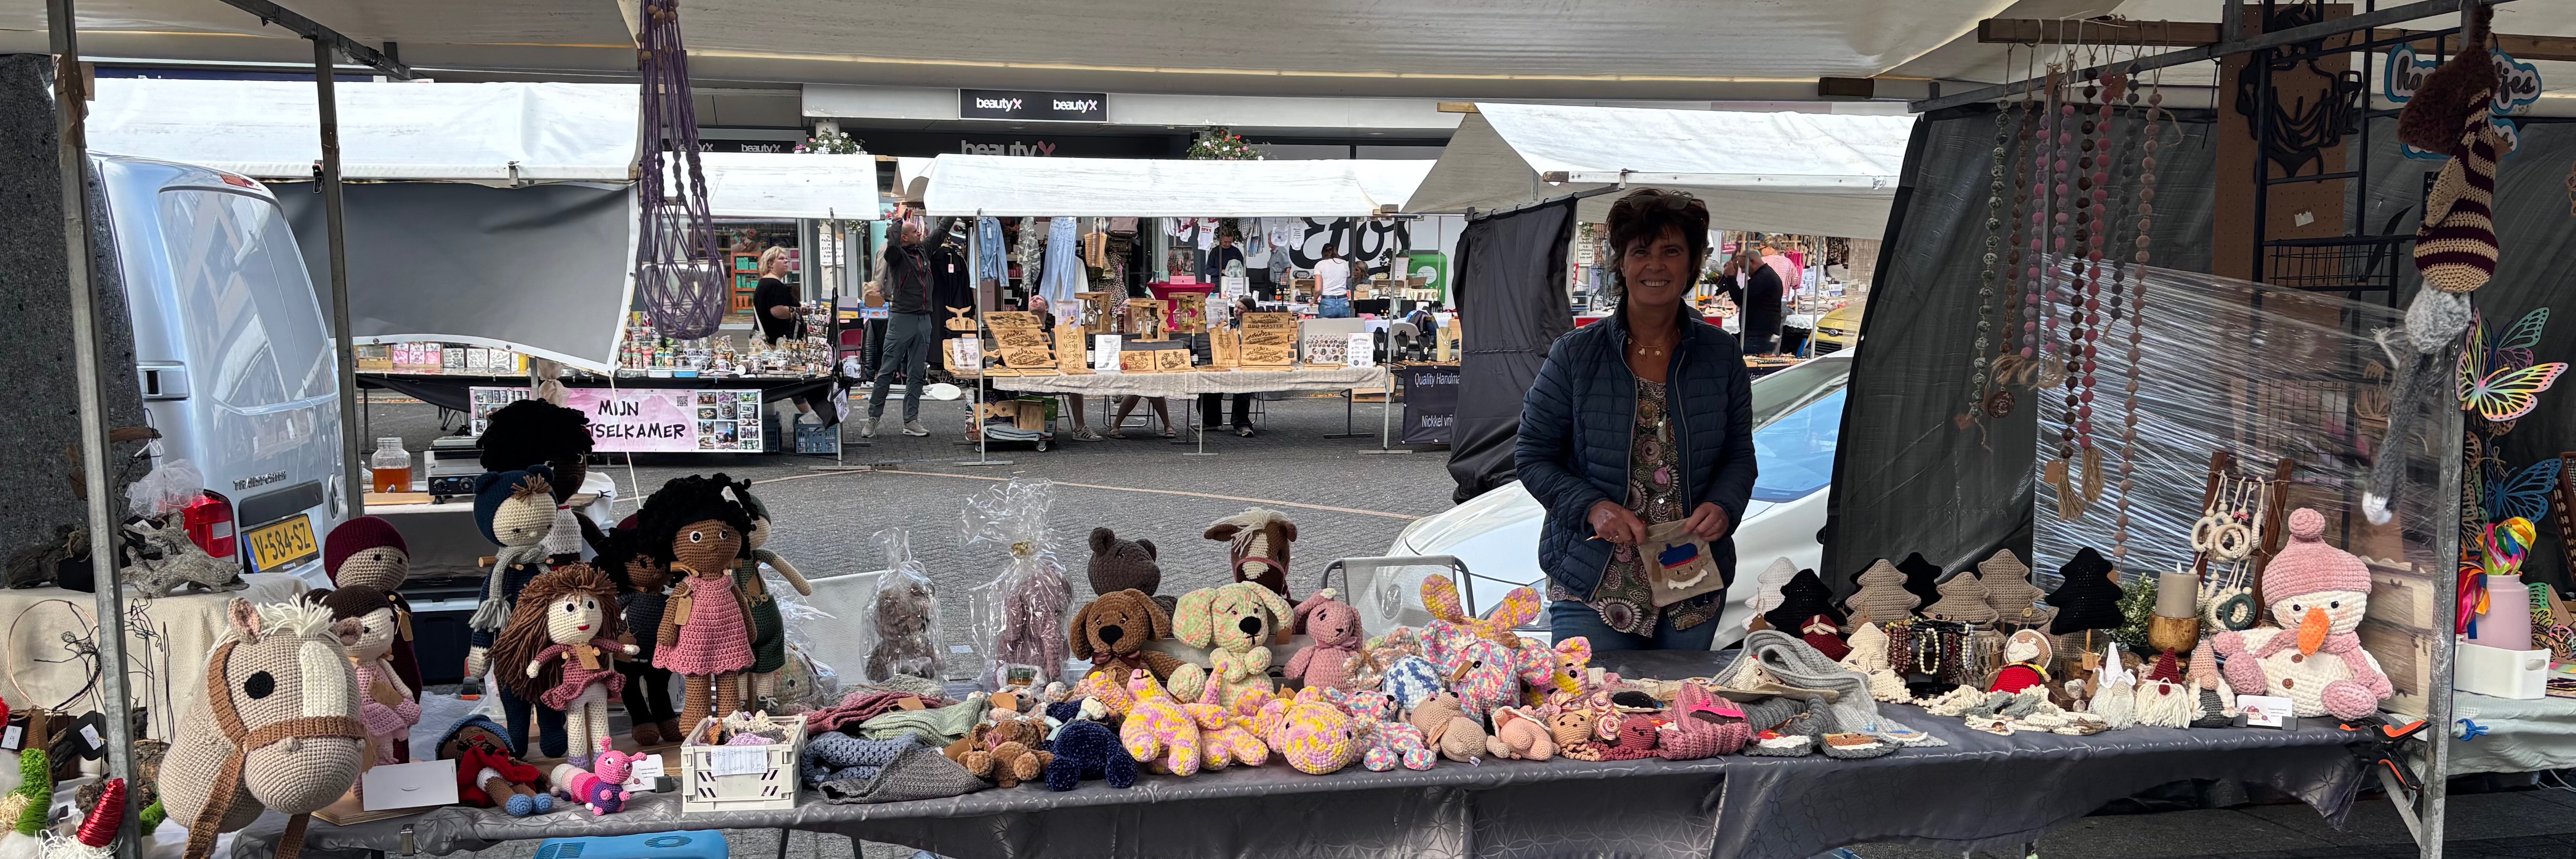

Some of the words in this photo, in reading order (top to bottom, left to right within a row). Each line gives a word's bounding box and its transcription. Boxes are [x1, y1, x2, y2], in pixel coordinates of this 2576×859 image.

[1414, 373, 1435, 387] Quality
[598, 400, 639, 416] MIJN
[1422, 415, 1443, 428] Nickkel
[254, 522, 311, 564] V-584-SZ
